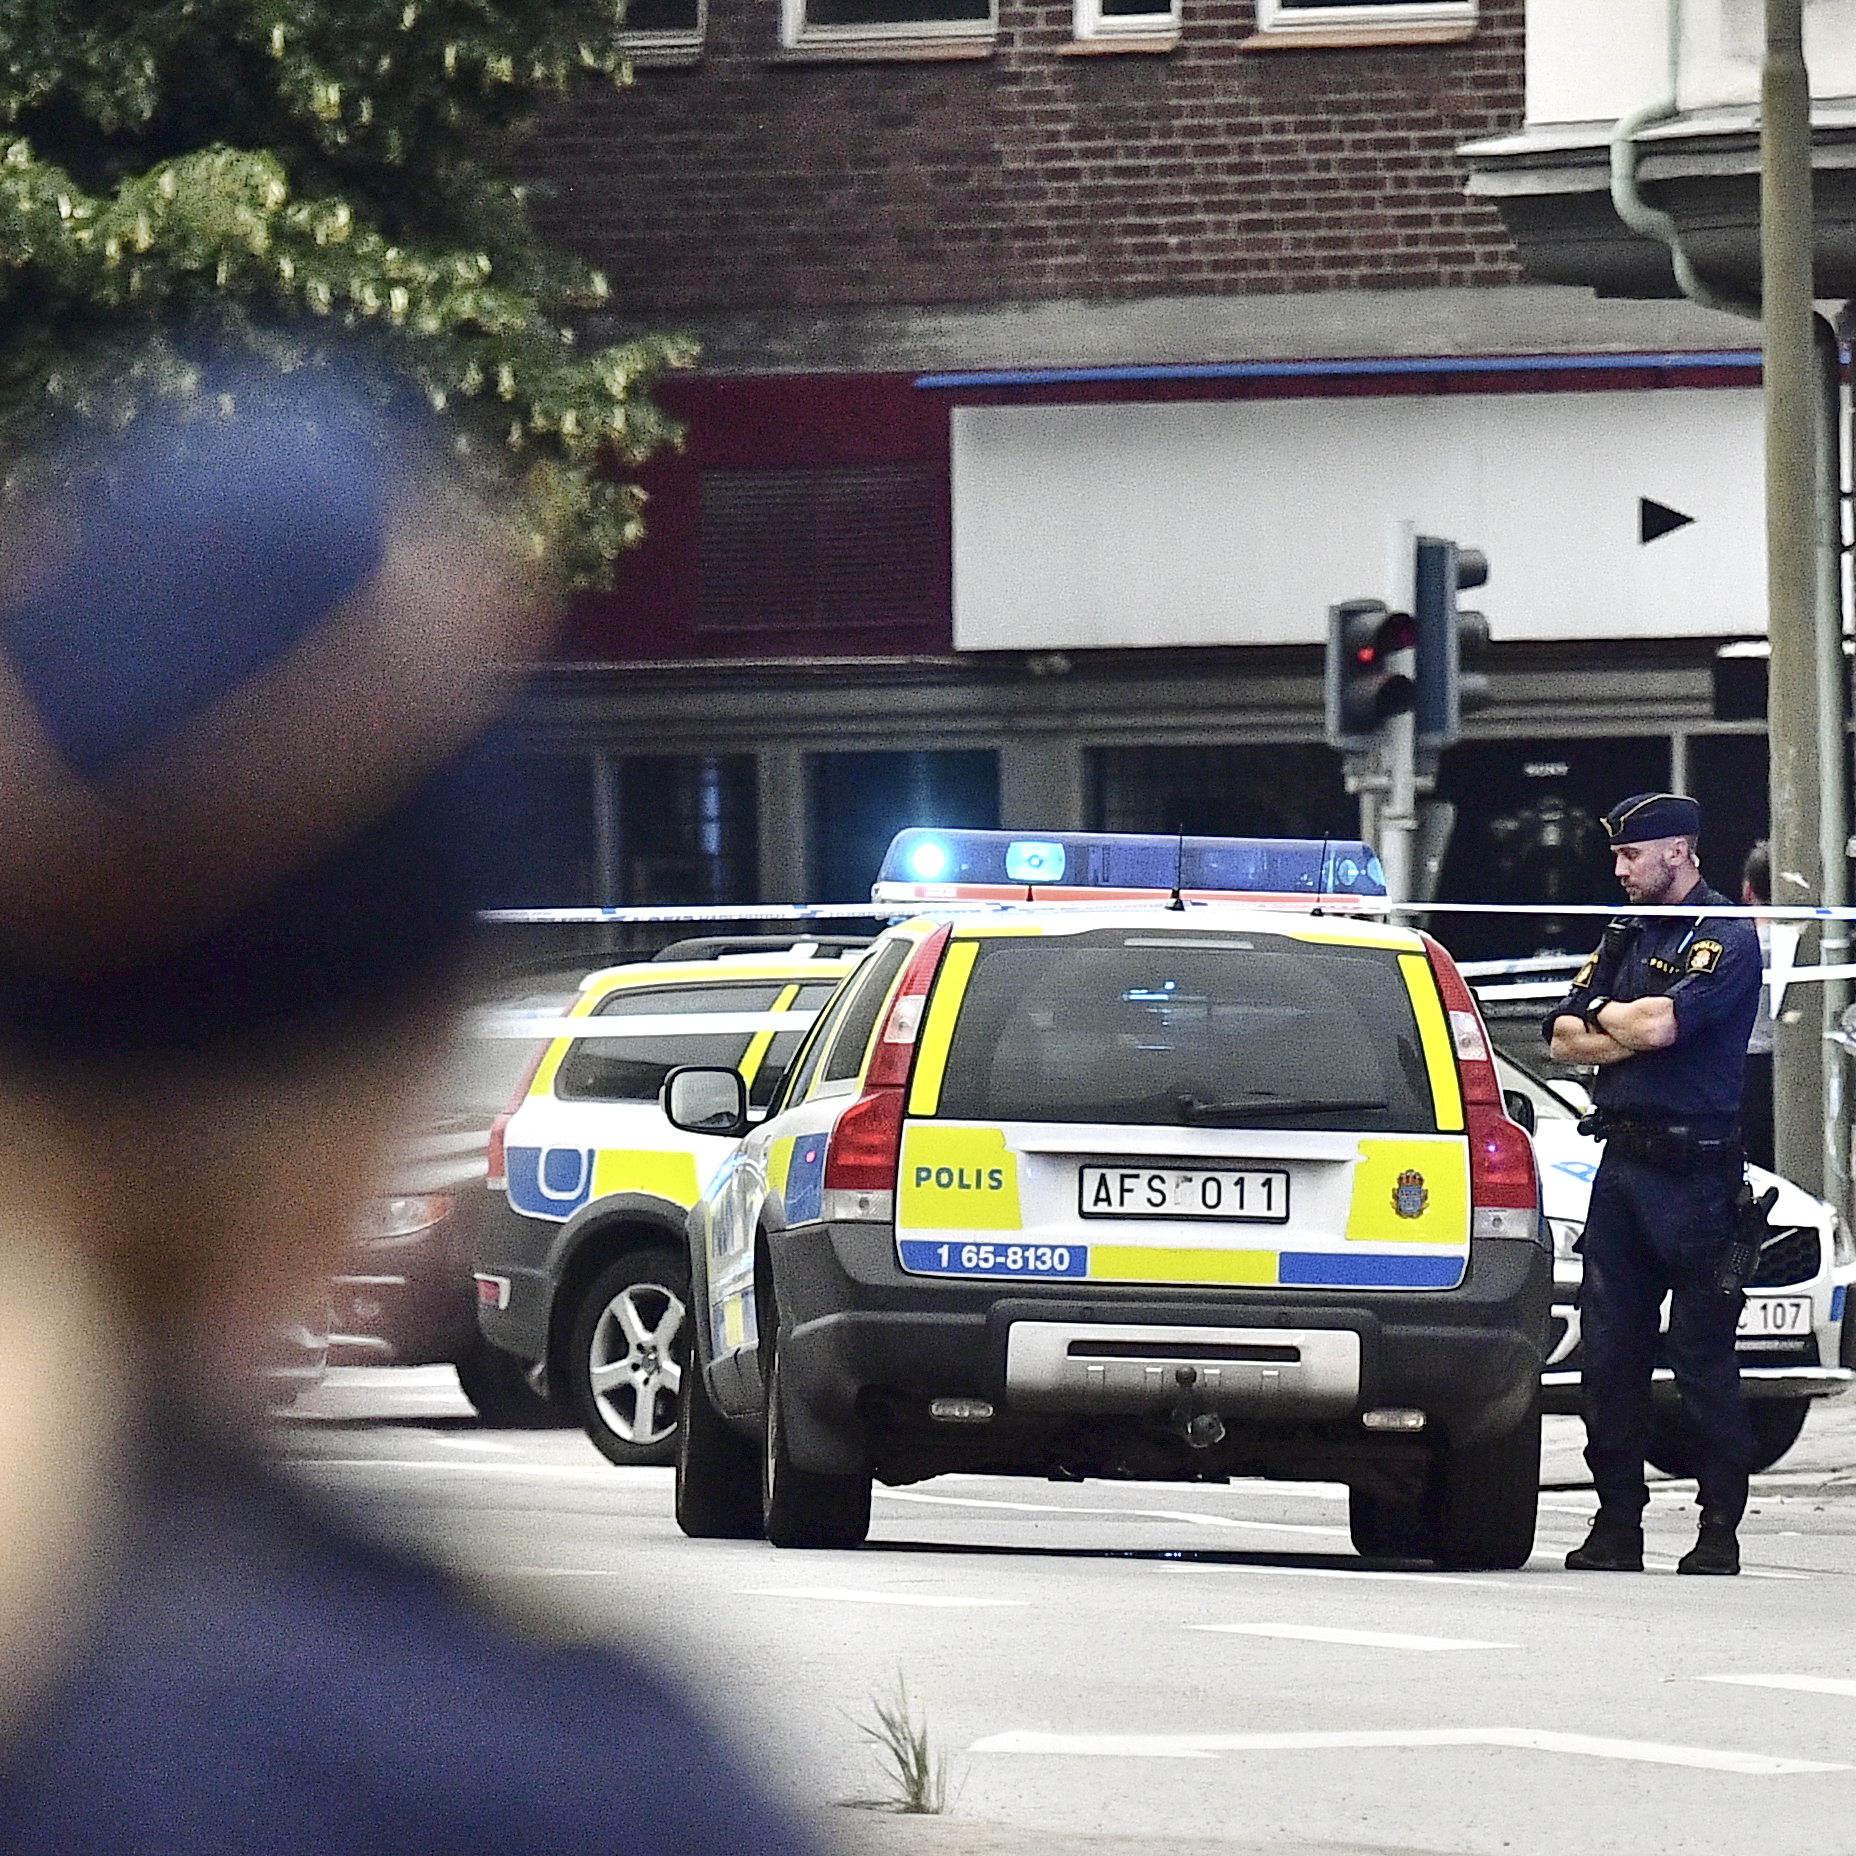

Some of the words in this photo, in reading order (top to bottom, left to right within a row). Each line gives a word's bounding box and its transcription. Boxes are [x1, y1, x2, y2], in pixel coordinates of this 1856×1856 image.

[914, 1166, 1004, 1192] POLIS
[1092, 1172, 1168, 1209] AFS
[1200, 1175, 1274, 1212] 011
[936, 1244, 950, 1268] 1
[961, 1245, 1071, 1271] 65-8130
[1760, 1302, 1801, 1330] 107
